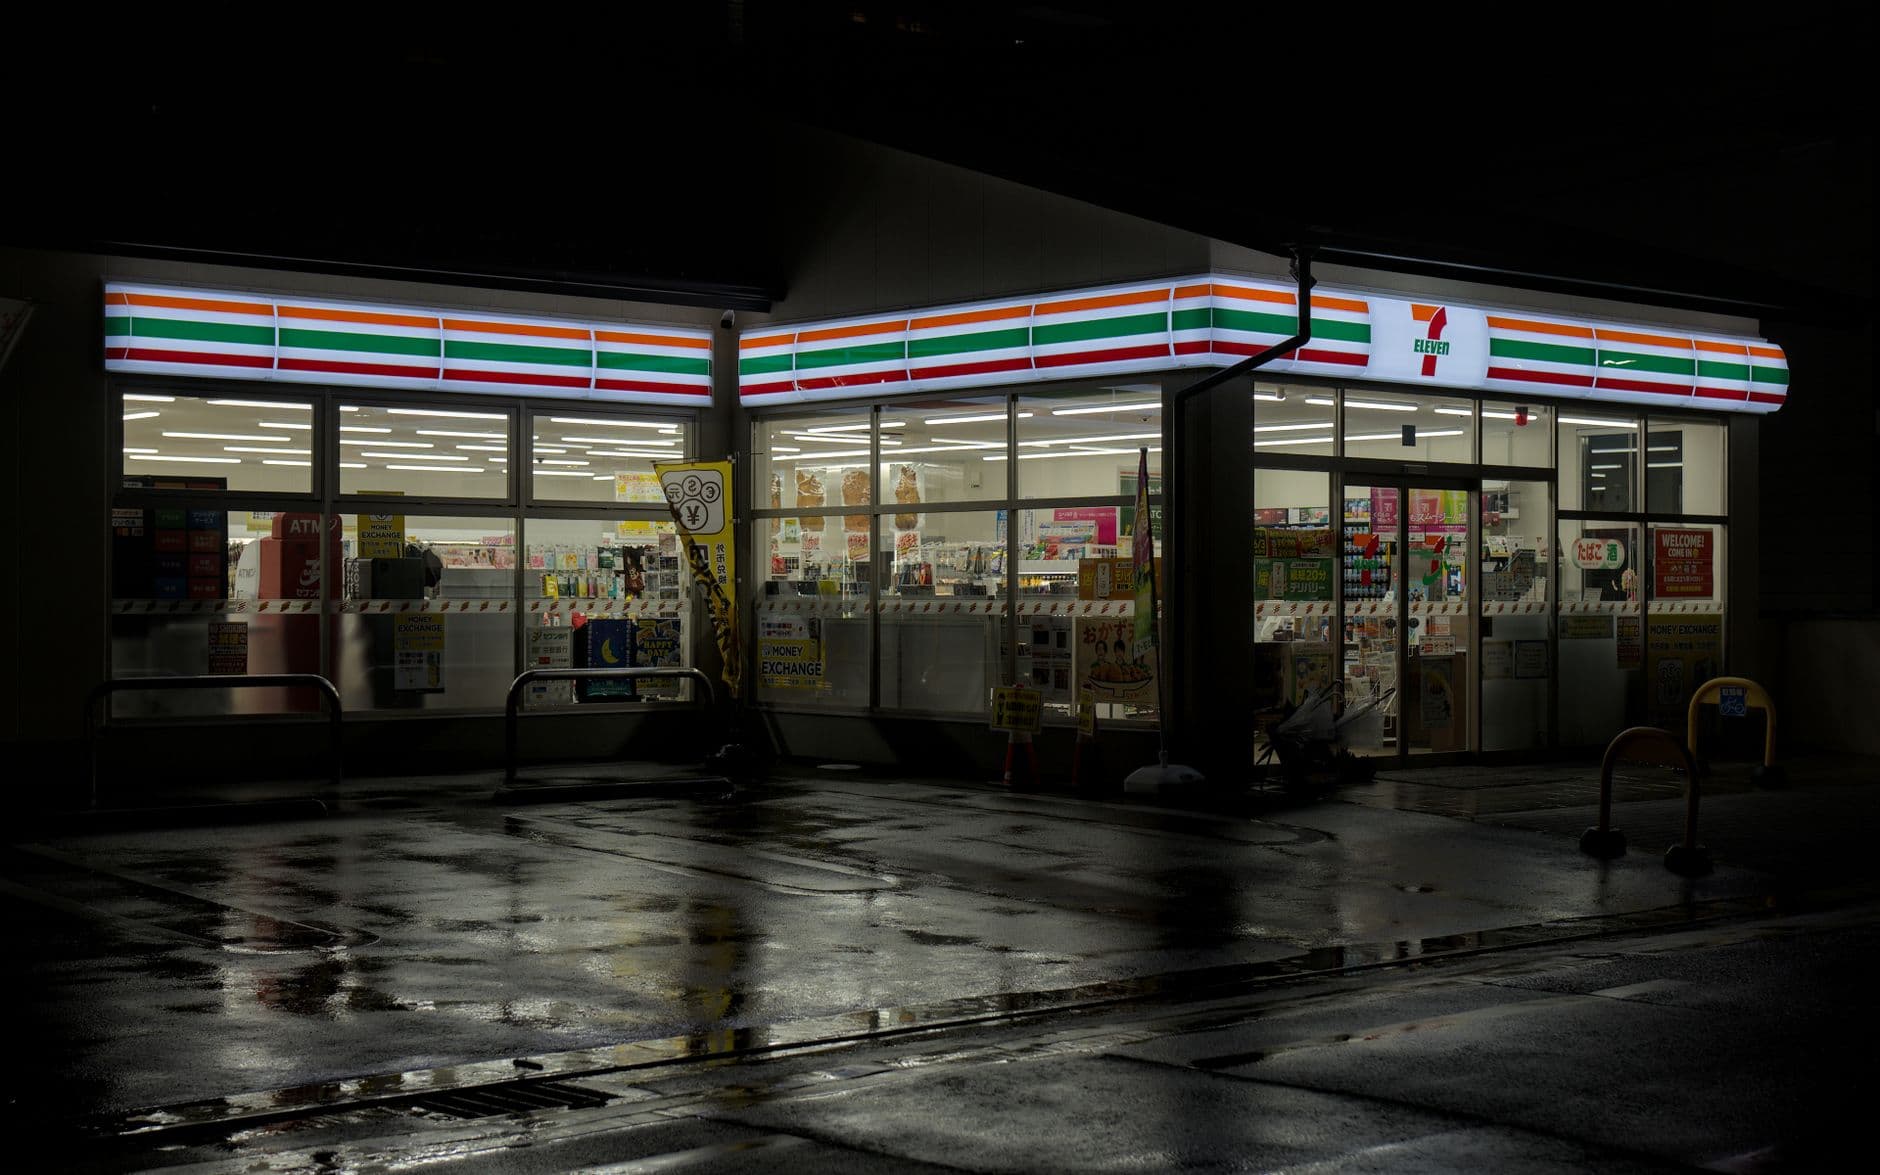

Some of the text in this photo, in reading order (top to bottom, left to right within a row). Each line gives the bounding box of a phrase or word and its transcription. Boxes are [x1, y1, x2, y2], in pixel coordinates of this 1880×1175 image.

[1411, 304, 1447, 376] 7
[1662, 533, 1705, 548] WELCOME!
[1577, 543, 1603, 561] たばこ
[1606, 543, 1618, 561] 酒
[1668, 547, 1685, 558] COME
[398, 624, 443, 632] EXCHANGE
[1649, 624, 1719, 634] MONEY EXCHANGE
[772, 646, 803, 657] MONEY
[761, 661, 822, 676] EXCHANGE
